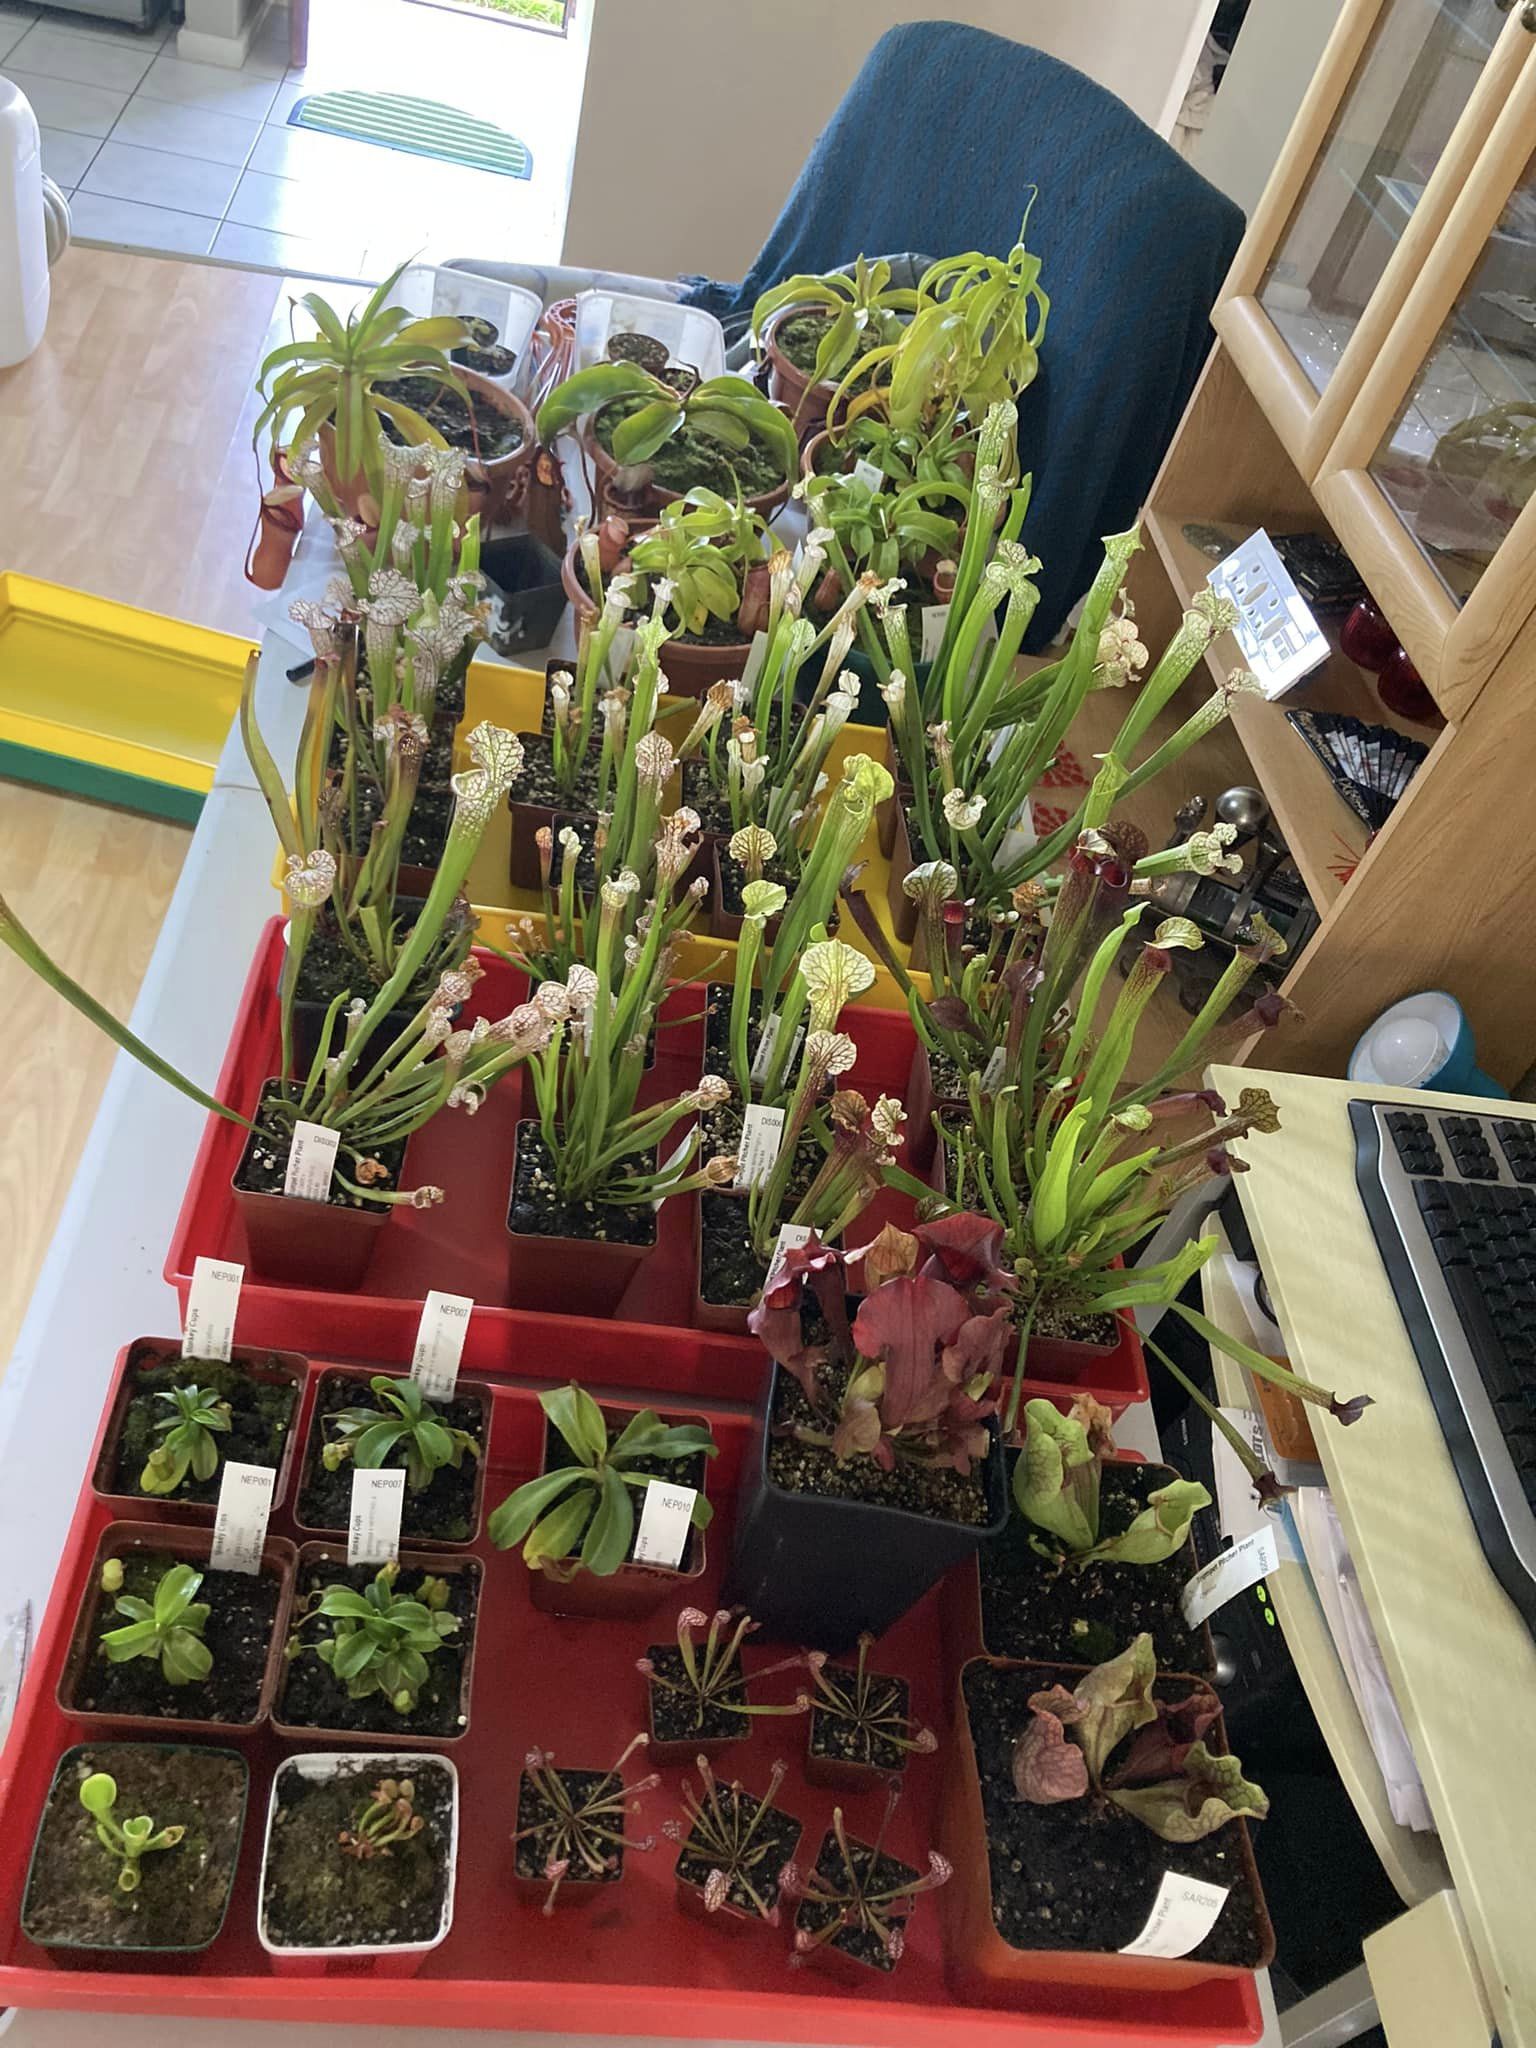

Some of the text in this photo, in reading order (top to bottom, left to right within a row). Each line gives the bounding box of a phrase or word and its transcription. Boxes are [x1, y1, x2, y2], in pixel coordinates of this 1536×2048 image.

[744, 1123, 752, 1141] Plant
[295, 1140, 304, 1156] Plant
[741, 1141, 750, 1162] Pitcher
[211, 1270, 240, 1282] NEP001
[189, 1308, 199, 1327] Cups
[440, 1304, 468, 1318] NEP007
[240, 1475, 272, 1487] NEP001
[371, 1480, 402, 1488] NEP007
[662, 1498, 691, 1512] NEP010
[353, 1515, 362, 1532] Cups
[1238, 1539, 1255, 1553] Plant
